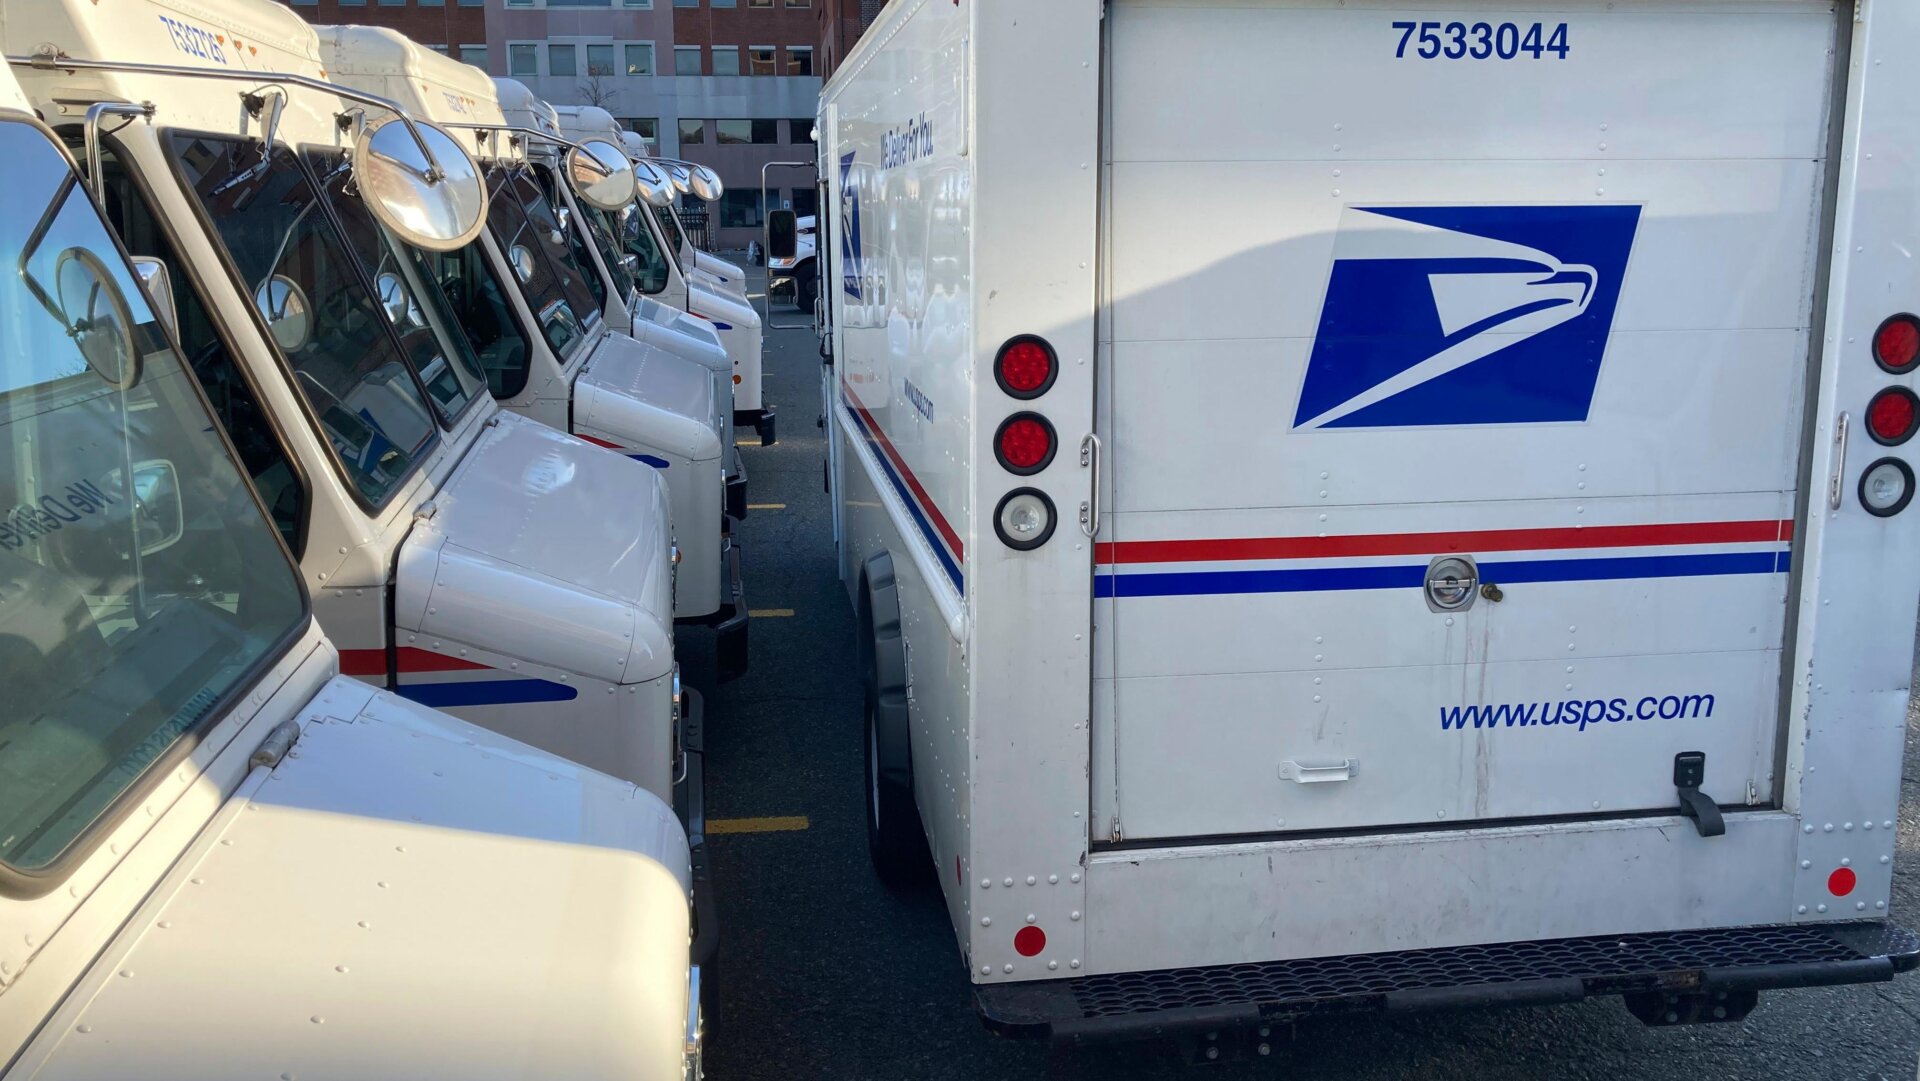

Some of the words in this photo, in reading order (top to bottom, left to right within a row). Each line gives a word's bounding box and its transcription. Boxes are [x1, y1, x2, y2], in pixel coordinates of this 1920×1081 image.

[1392, 21, 1570, 60] 7533044
[880, 132, 889, 171] We
[889, 126, 909, 168] Deliver
[908, 118, 919, 162] For
[1440, 694, 1715, 732] www.usps.com
